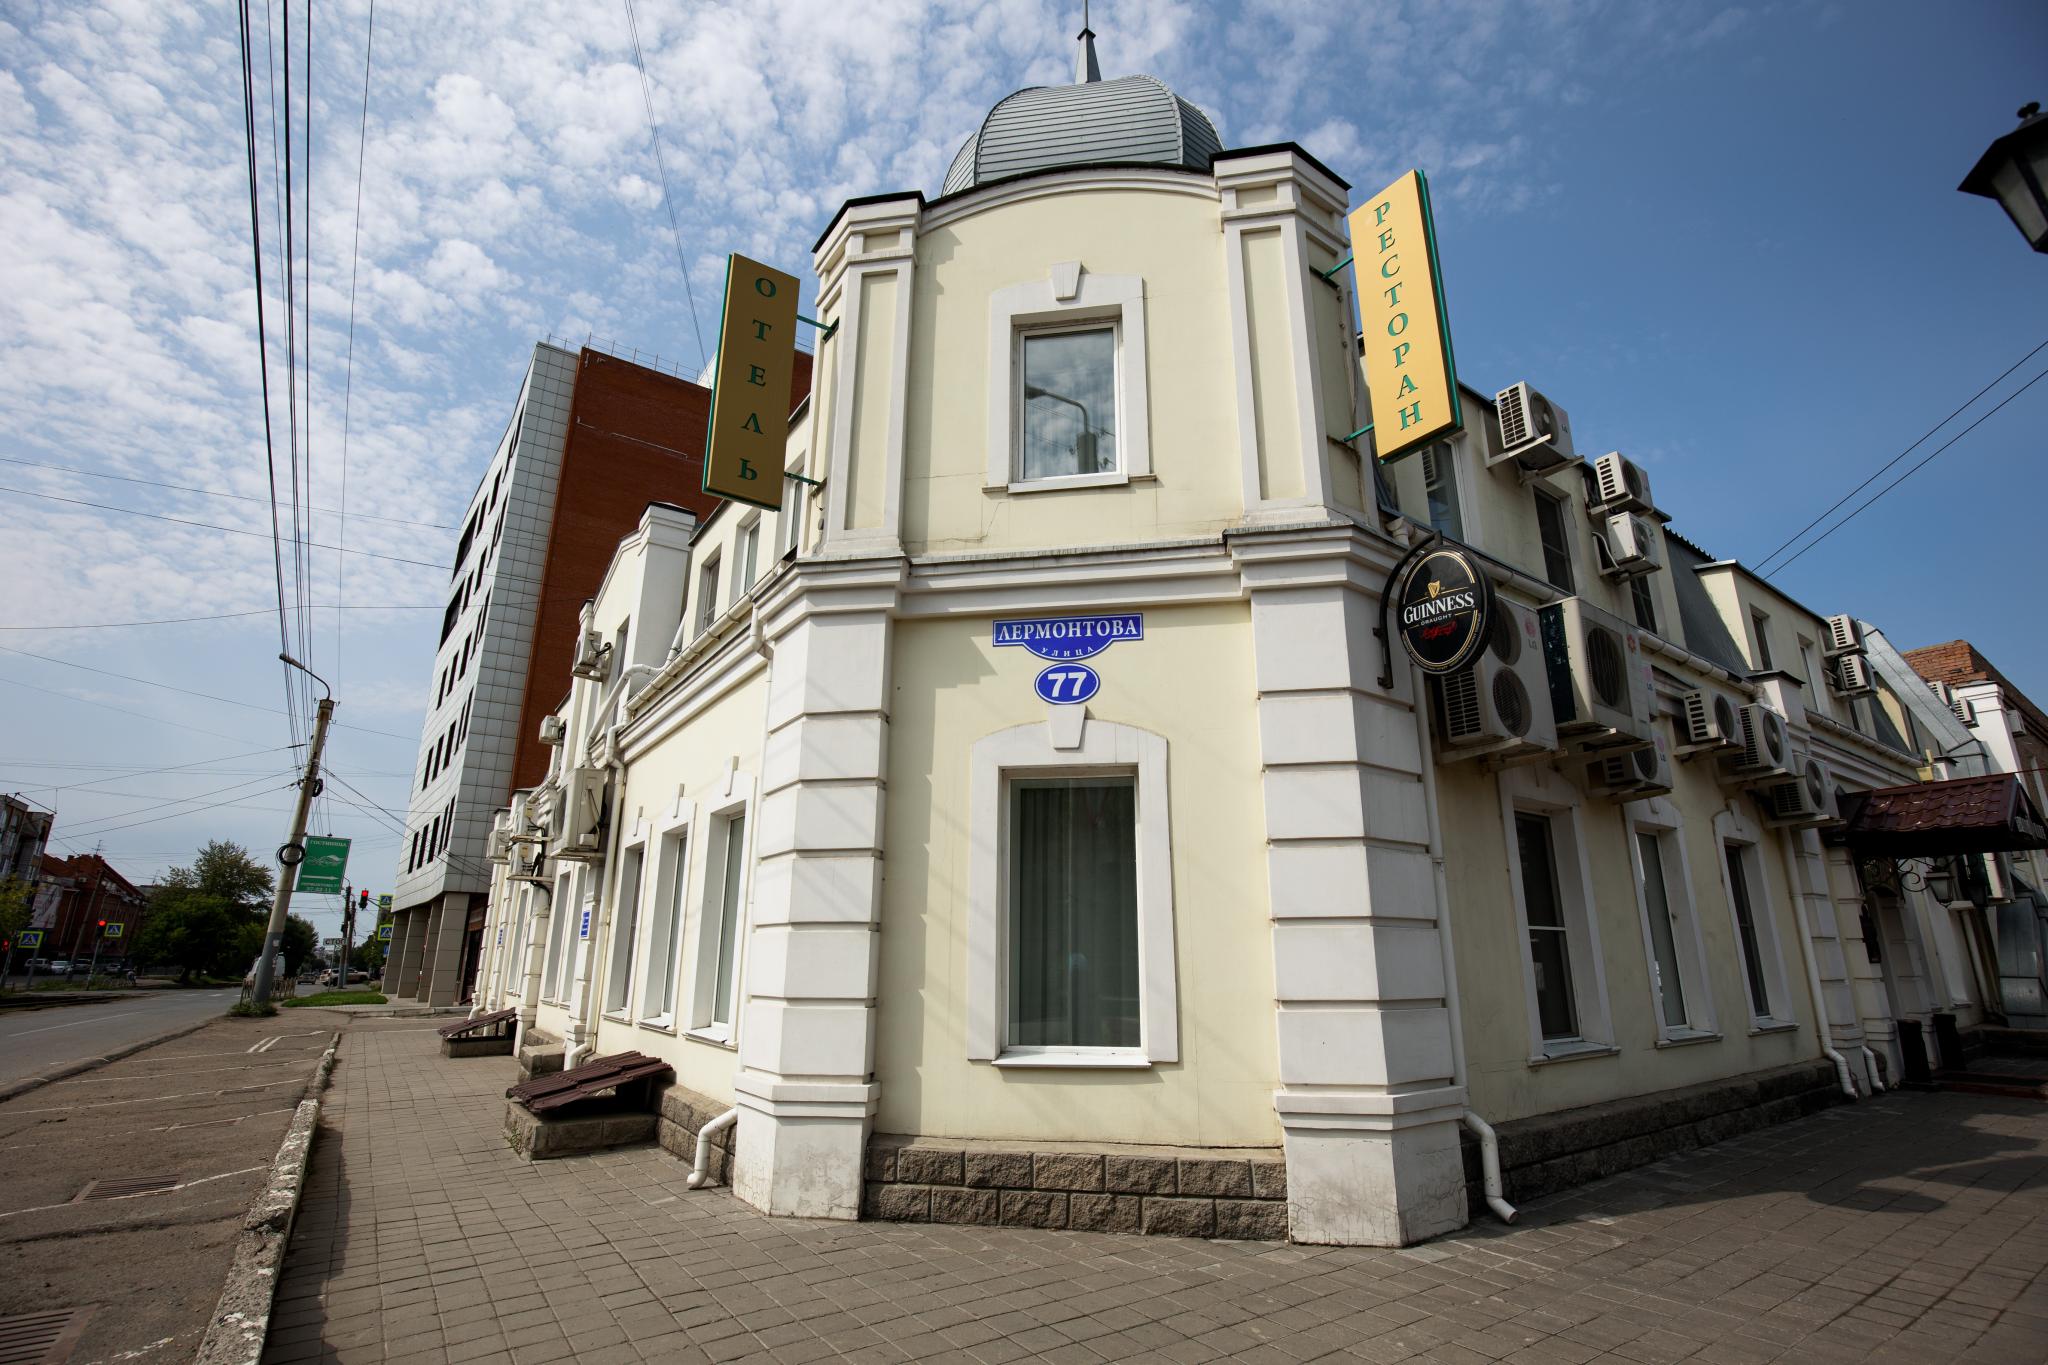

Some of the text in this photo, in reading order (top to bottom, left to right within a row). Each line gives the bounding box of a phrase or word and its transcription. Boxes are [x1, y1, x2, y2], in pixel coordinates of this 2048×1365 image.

[1374, 201, 1424, 431] РЕСТОРАН
[737, 277, 777, 481] ОТЕЛЬ
[1403, 591, 1475, 624] GUINNESS
[1420, 613, 1452, 626] DRAUGHT
[998, 619, 1138, 641] ЛЕРМОНТОВА
[1041, 646, 1094, 657] УЛИЦА
[1047, 671, 1087, 697] 77
